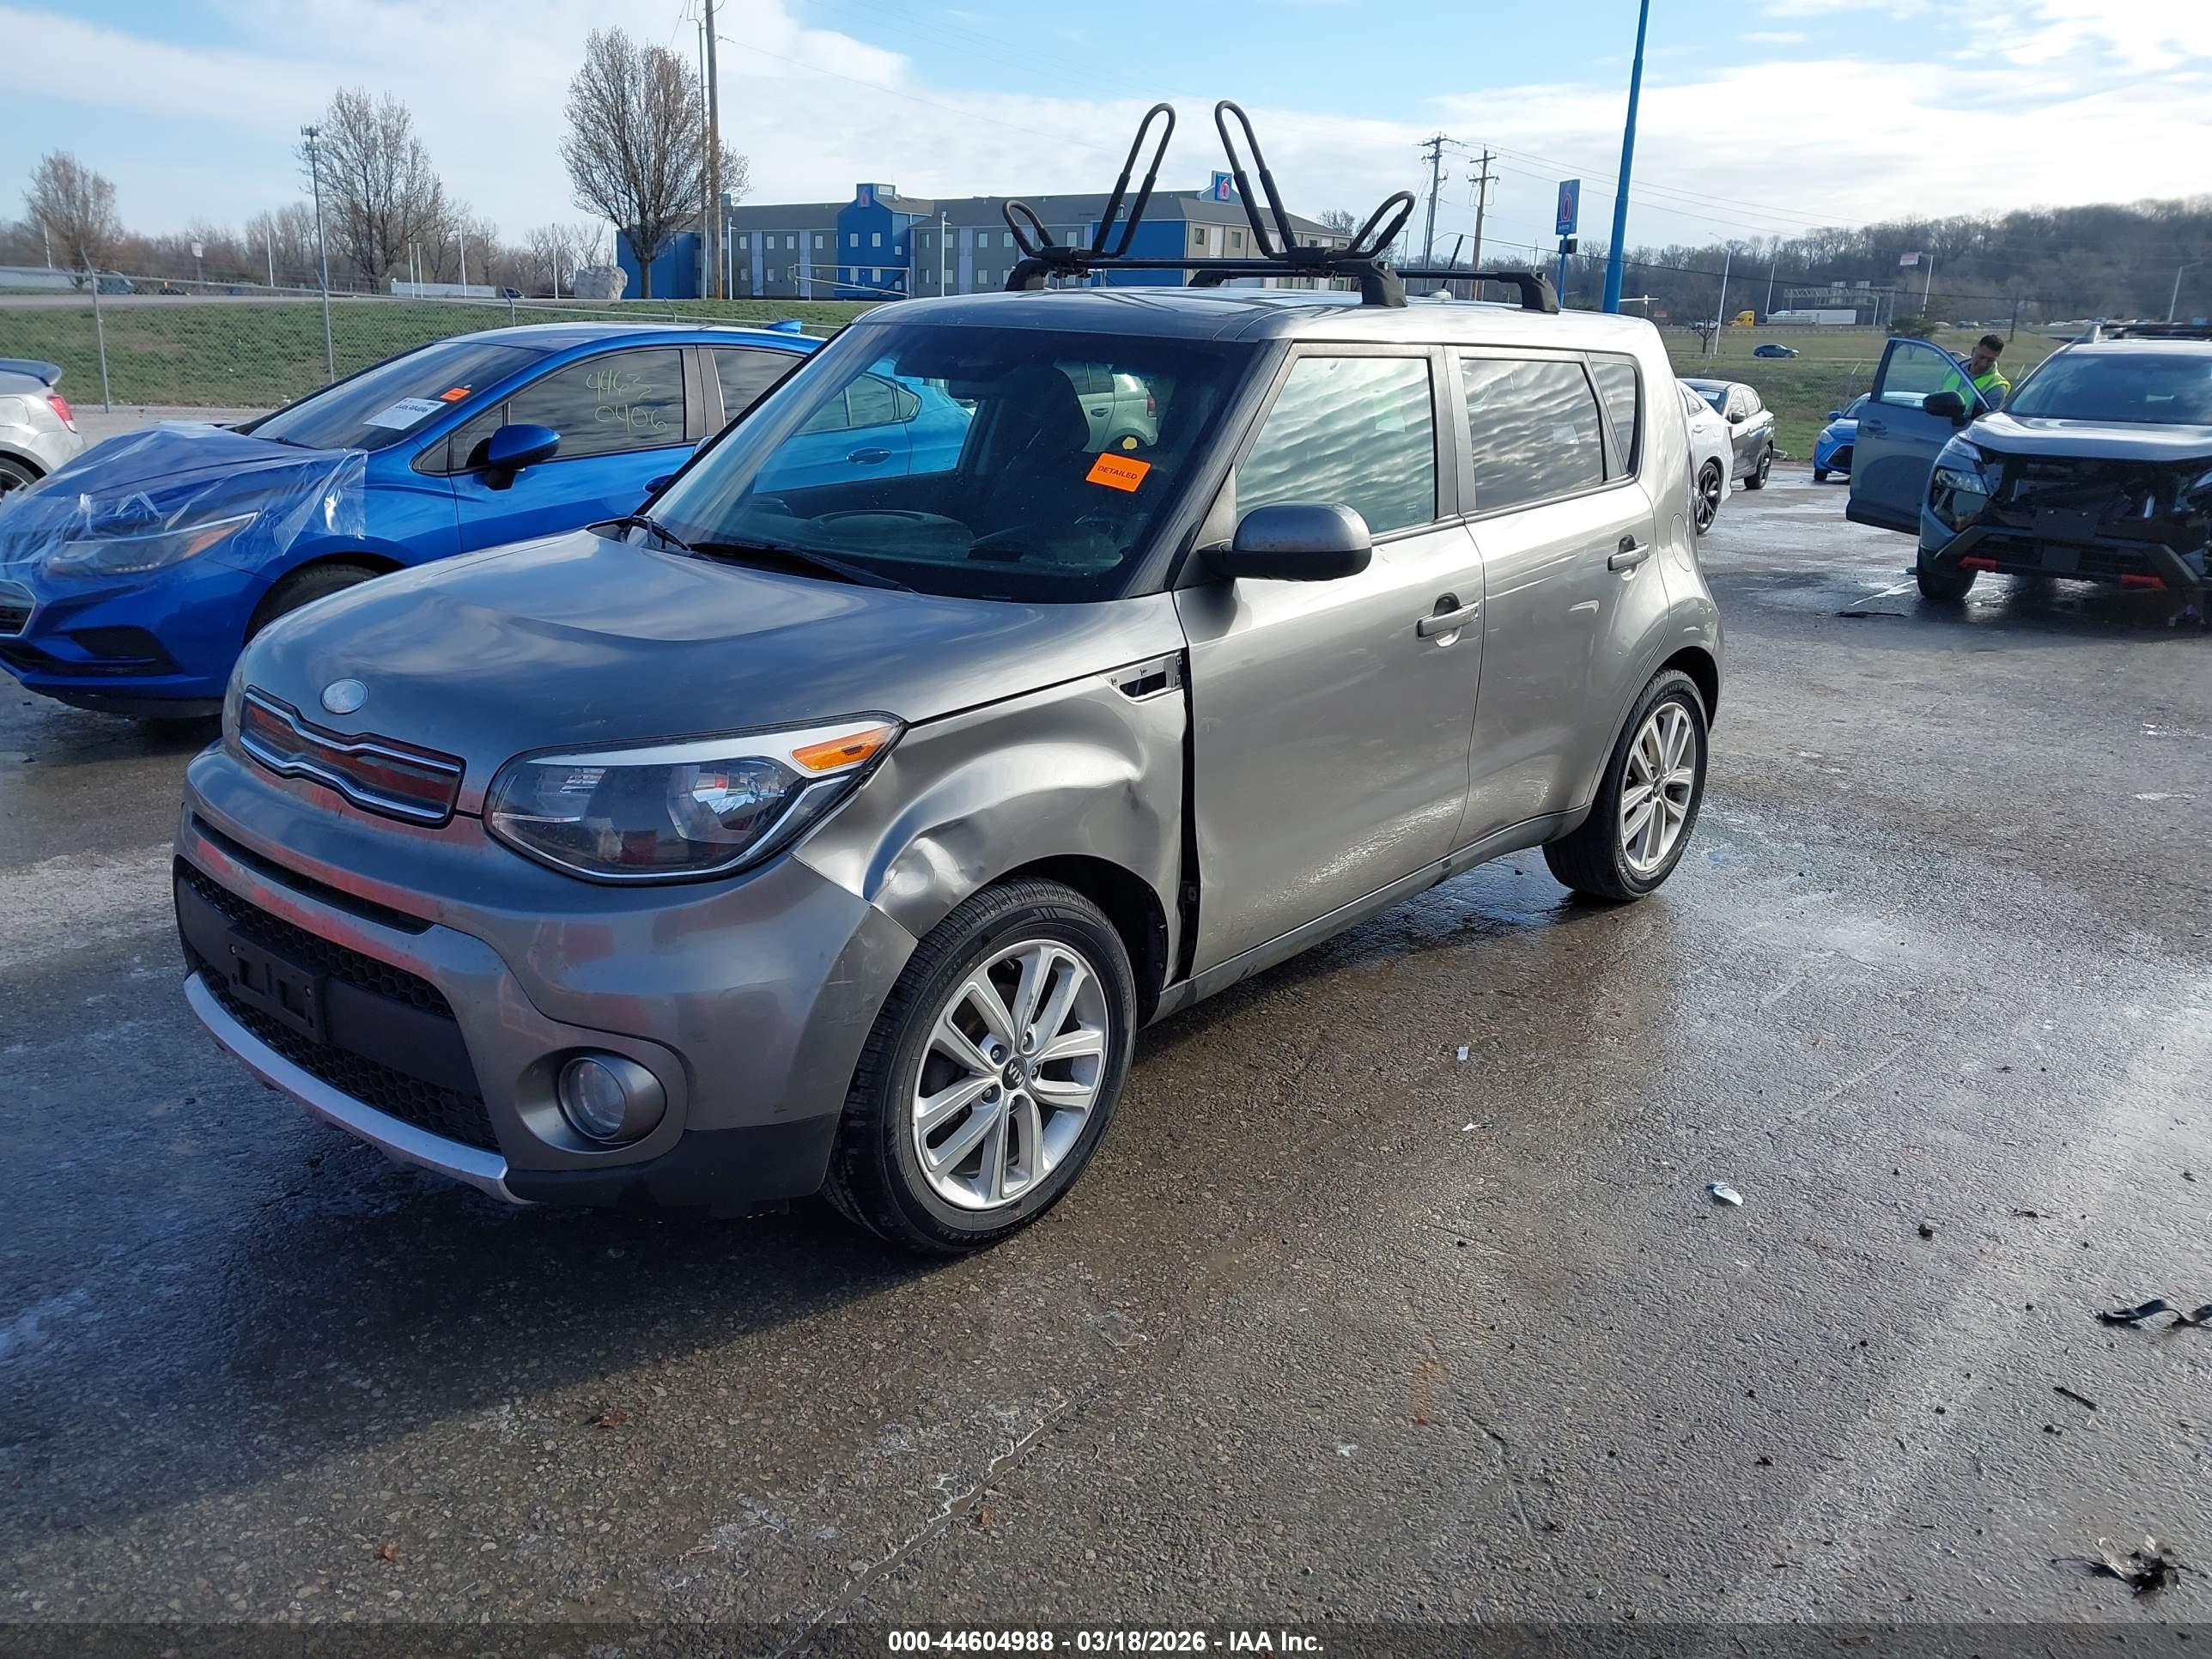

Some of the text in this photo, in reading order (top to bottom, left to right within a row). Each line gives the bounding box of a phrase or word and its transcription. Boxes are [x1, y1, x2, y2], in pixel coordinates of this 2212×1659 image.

[586, 369, 653, 402] 4463
[594, 404, 667, 433] 0406
[1097, 465, 1138, 480] DETAILED
[1008, 1063, 1024, 1085] KIA
